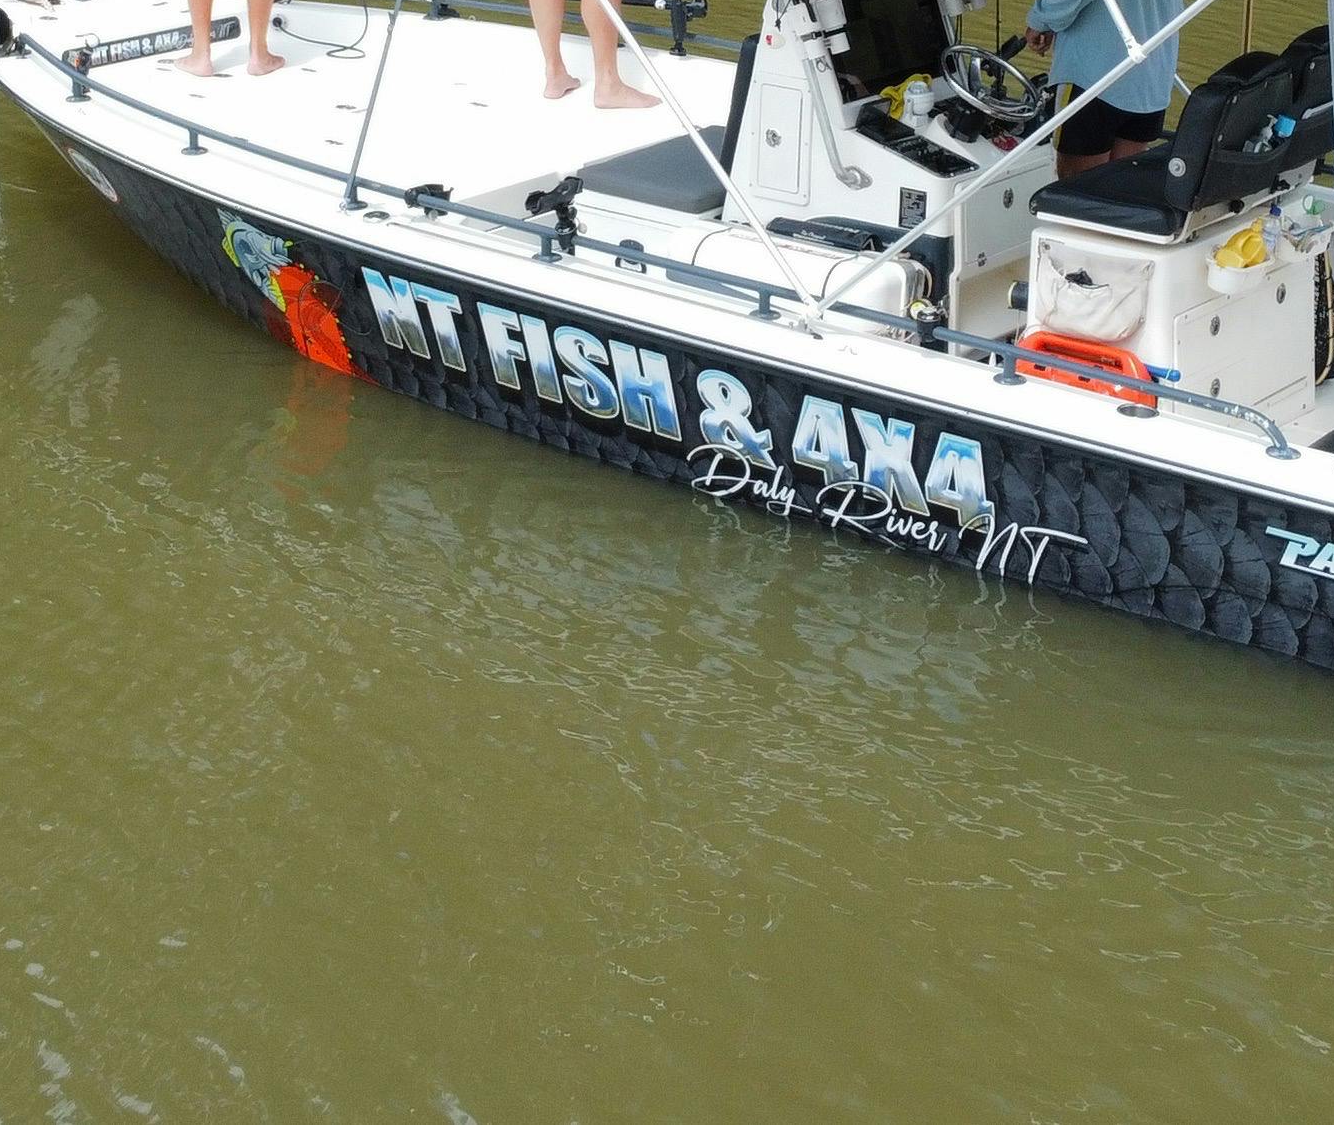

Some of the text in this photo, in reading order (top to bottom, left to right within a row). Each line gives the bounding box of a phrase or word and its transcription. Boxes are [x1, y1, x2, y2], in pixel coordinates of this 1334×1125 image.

[109, 39, 141, 62] FISH
[361, 266, 995, 532] NT FISH & 4X4
[687, 444, 1088, 584] Daly River NT
